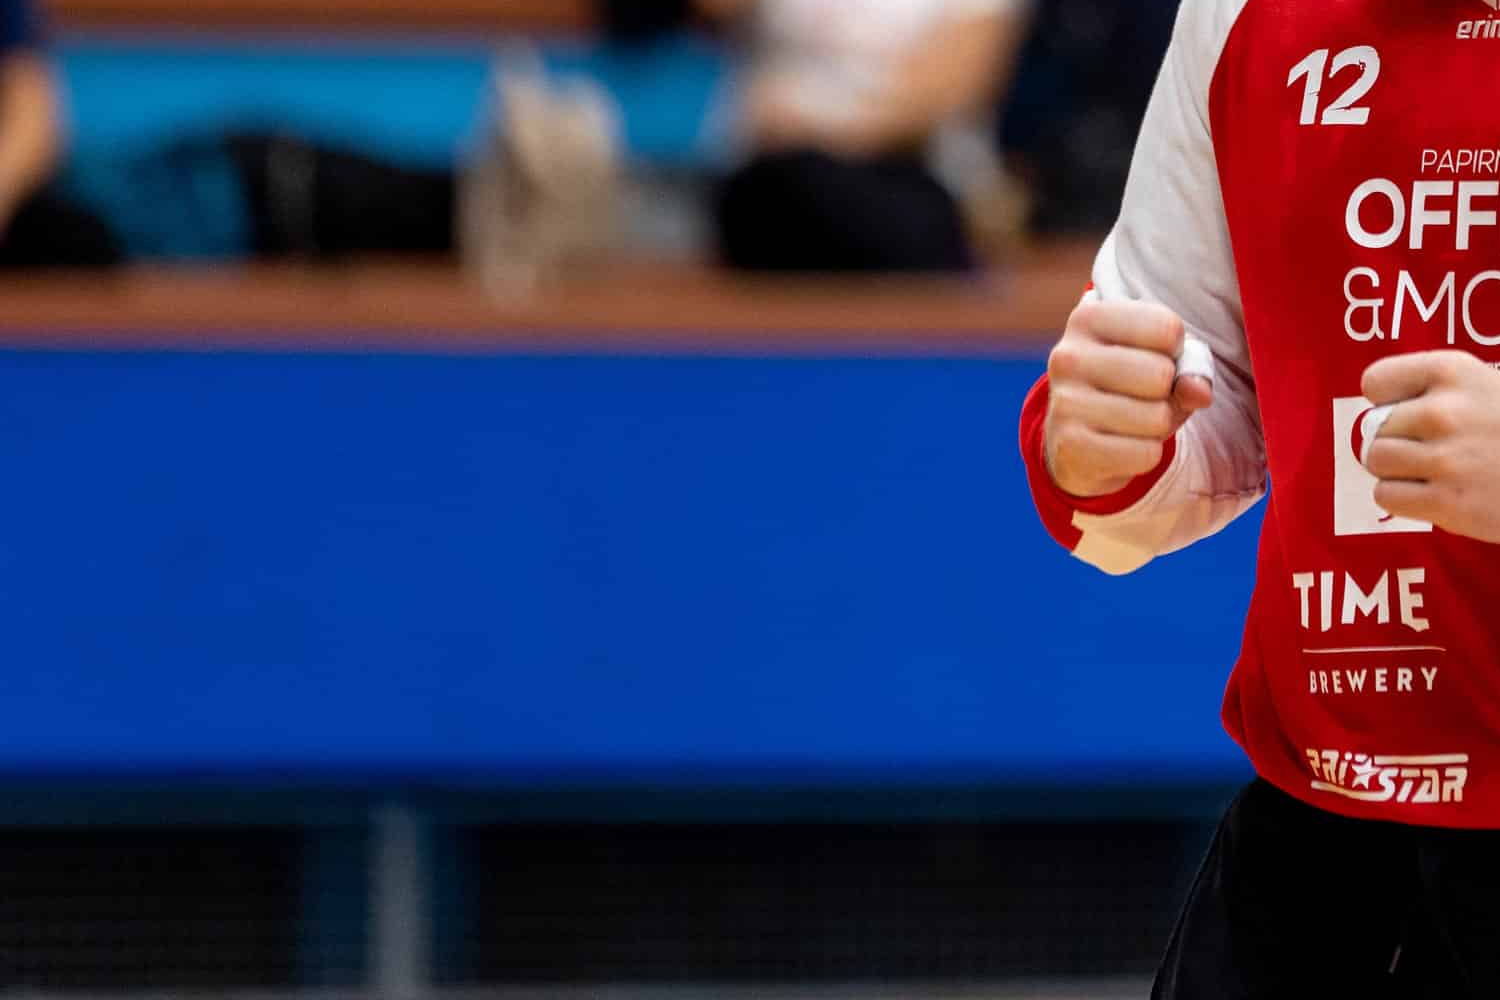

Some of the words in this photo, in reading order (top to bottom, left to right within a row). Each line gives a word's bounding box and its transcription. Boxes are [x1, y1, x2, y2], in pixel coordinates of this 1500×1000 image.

[1287, 45, 1381, 125] 12
[1293, 567, 1430, 632] TIME
[1309, 667, 1438, 695] BREWERY
